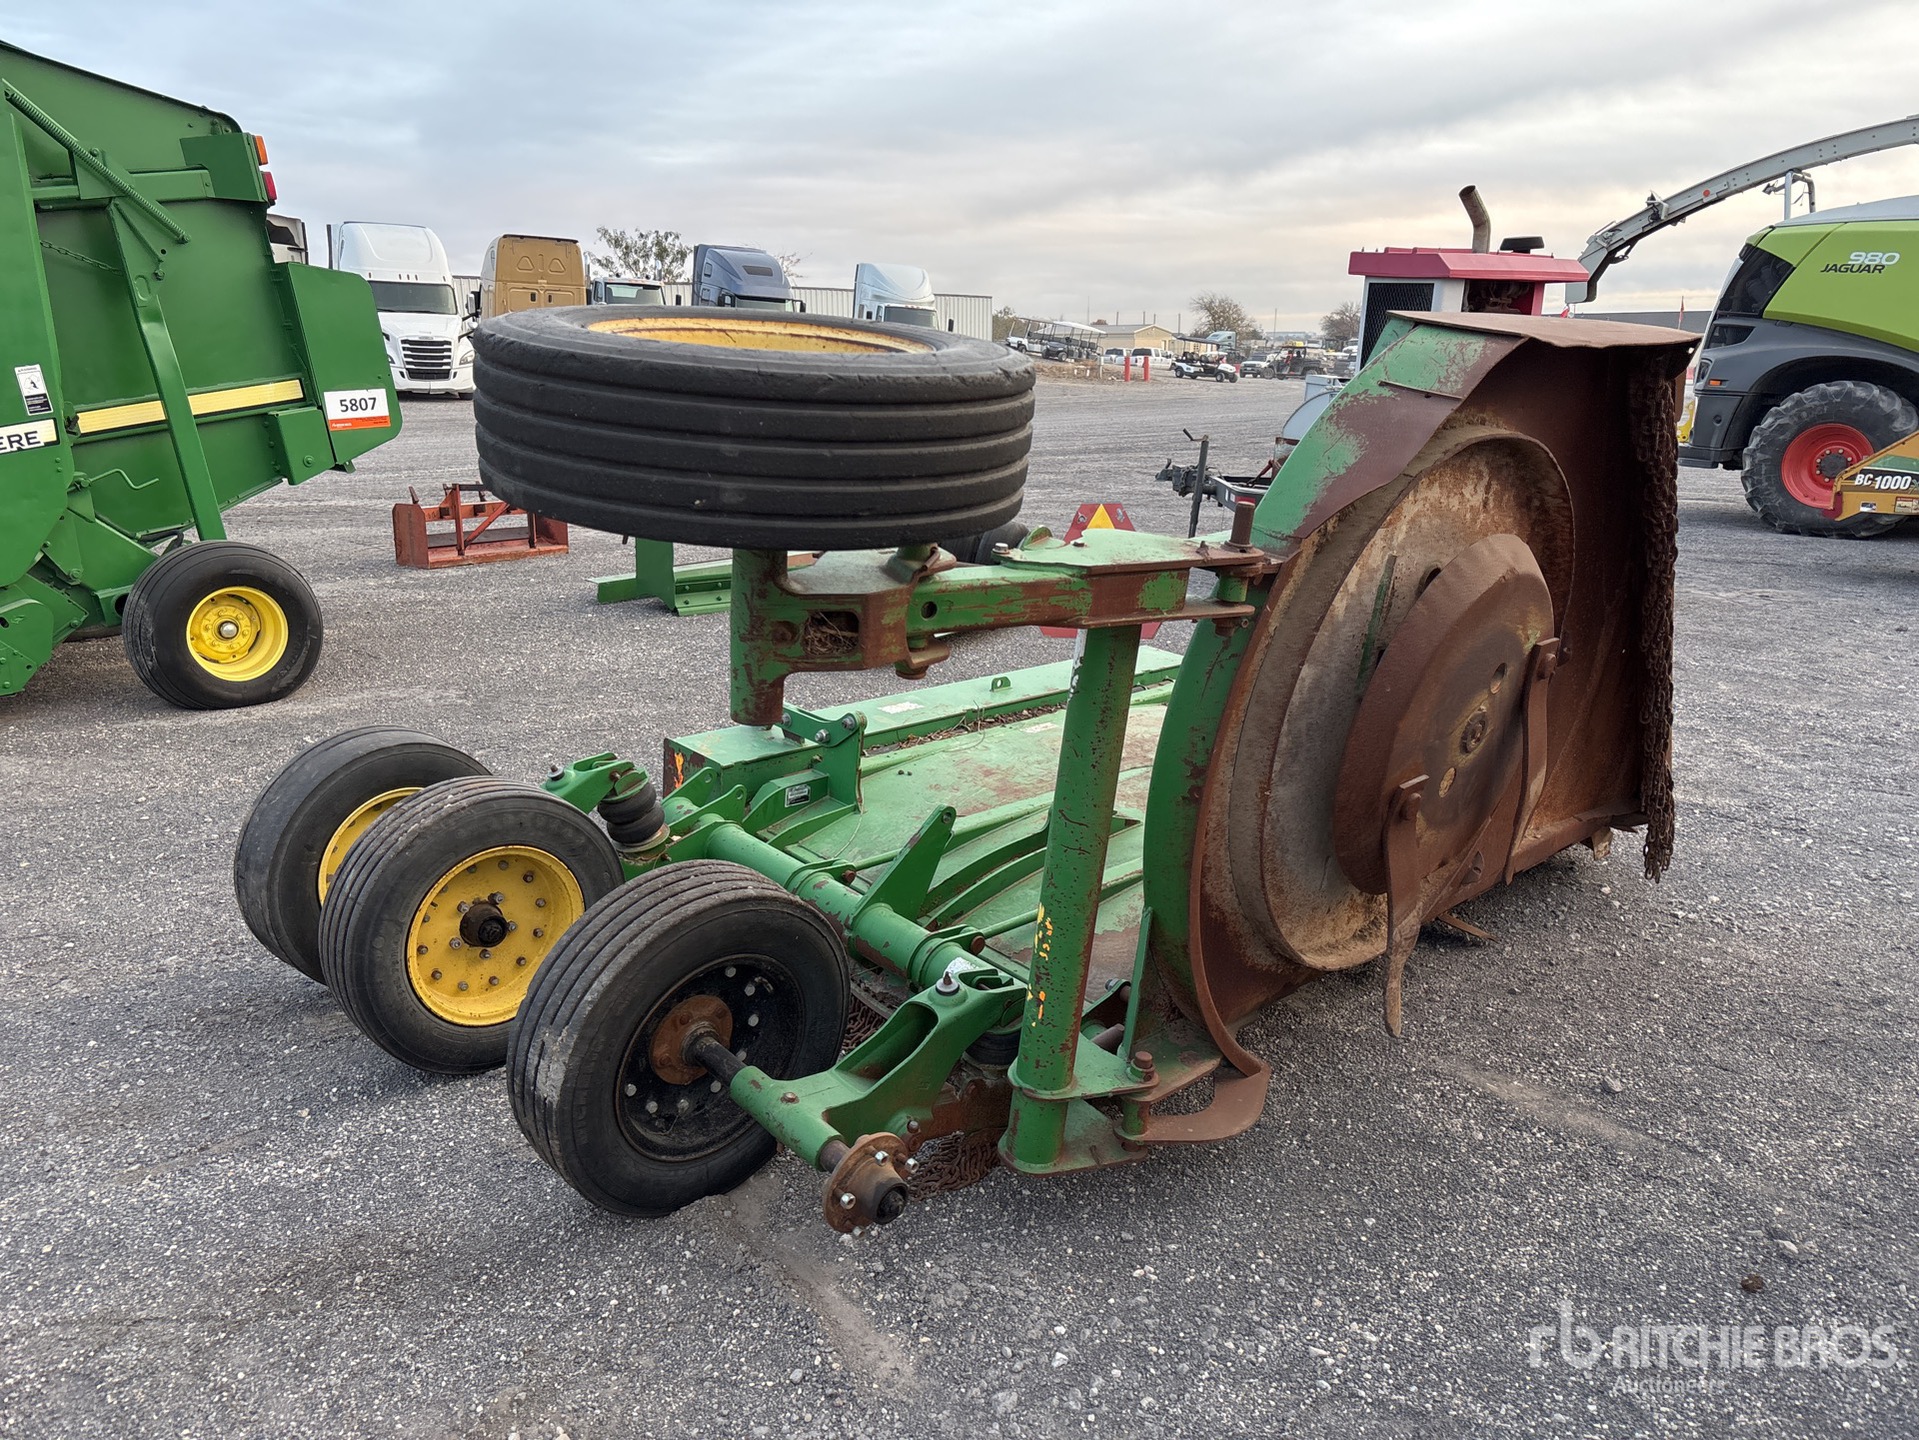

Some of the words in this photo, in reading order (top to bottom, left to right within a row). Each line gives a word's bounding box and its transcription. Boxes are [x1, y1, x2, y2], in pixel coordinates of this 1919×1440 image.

[1848, 252, 1900, 265] 980
[1820, 263, 1886, 274] JAGUAR
[340, 397, 377, 413] 5807
[1855, 474, 1874, 486] BC
[1874, 475, 1911, 490] 1000
